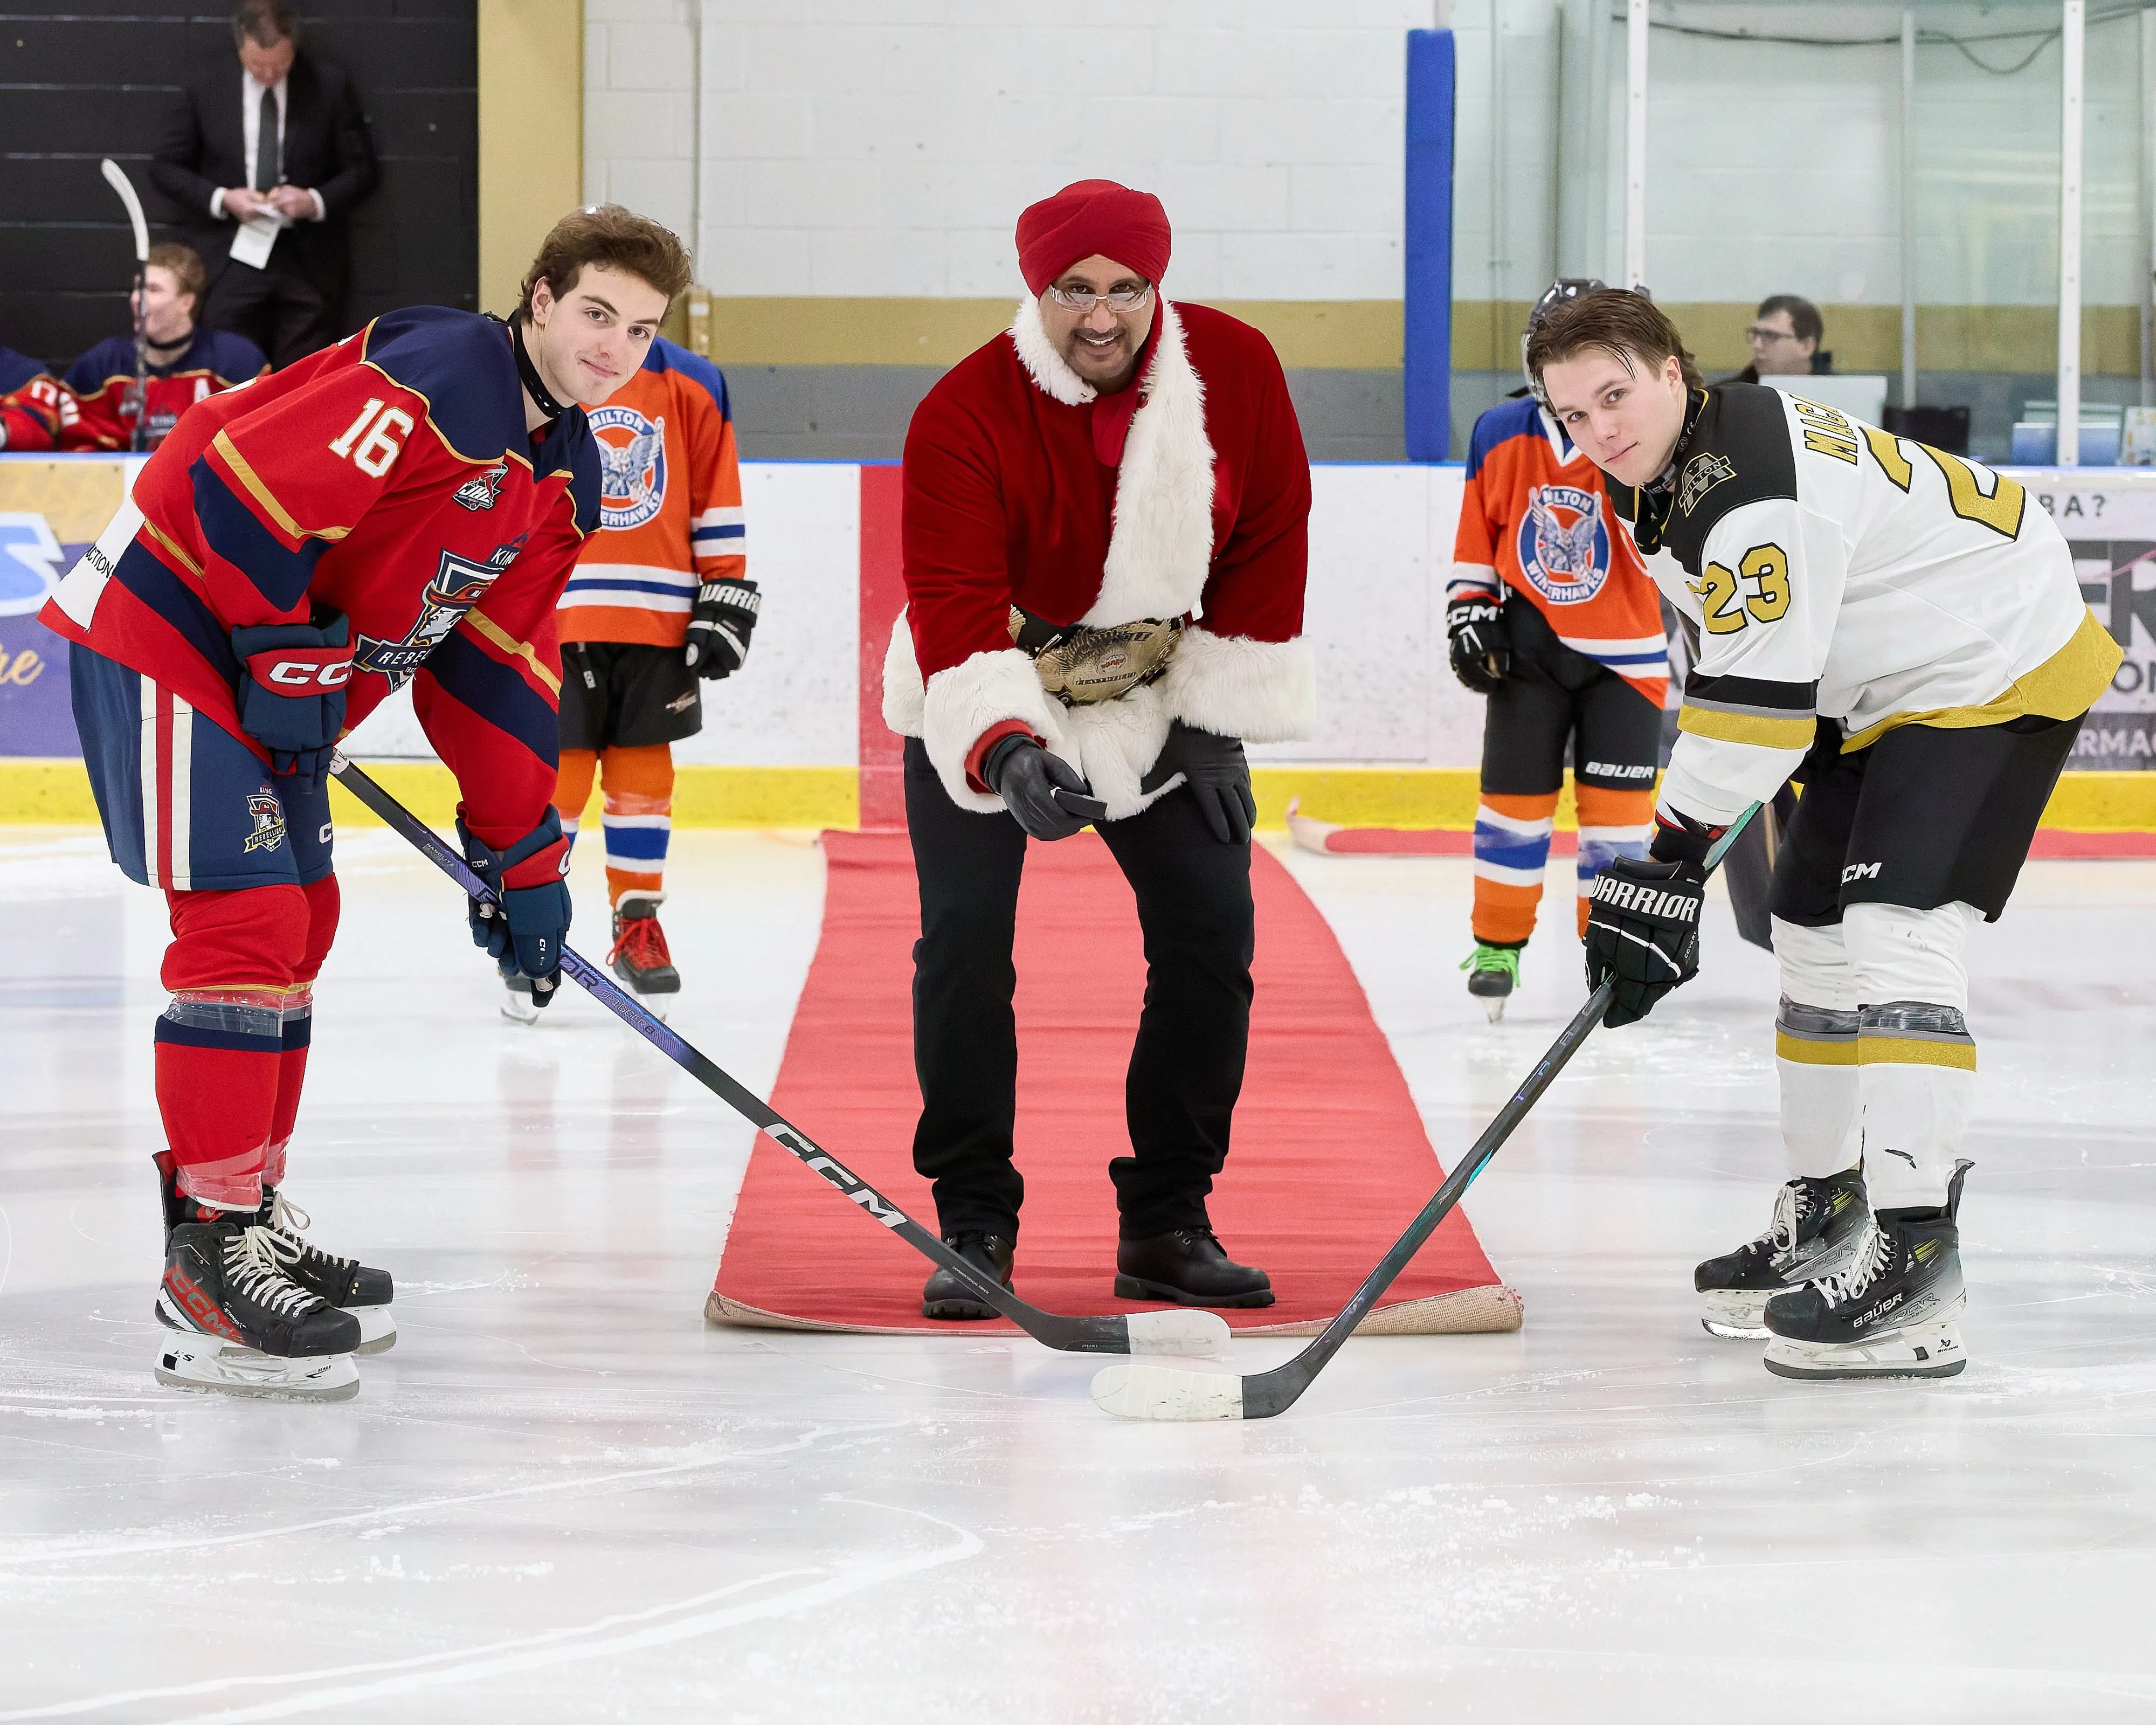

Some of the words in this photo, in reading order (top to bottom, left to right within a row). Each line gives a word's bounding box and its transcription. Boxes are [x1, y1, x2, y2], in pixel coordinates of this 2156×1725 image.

[590, 410, 645, 431] MILTON
[328, 398, 414, 479] 16
[1684, 461, 1722, 499] MILTON
[601, 491, 661, 526] ERHAWKS
[1684, 542, 1791, 634] 23
[270, 661, 353, 685] CC
[260, 786, 272, 795] KING
[472, 859, 488, 868] CCM
[1841, 862, 1882, 887] CM
[1684, 930, 1698, 960] COVERT
[763, 1123, 909, 1228] CCM
